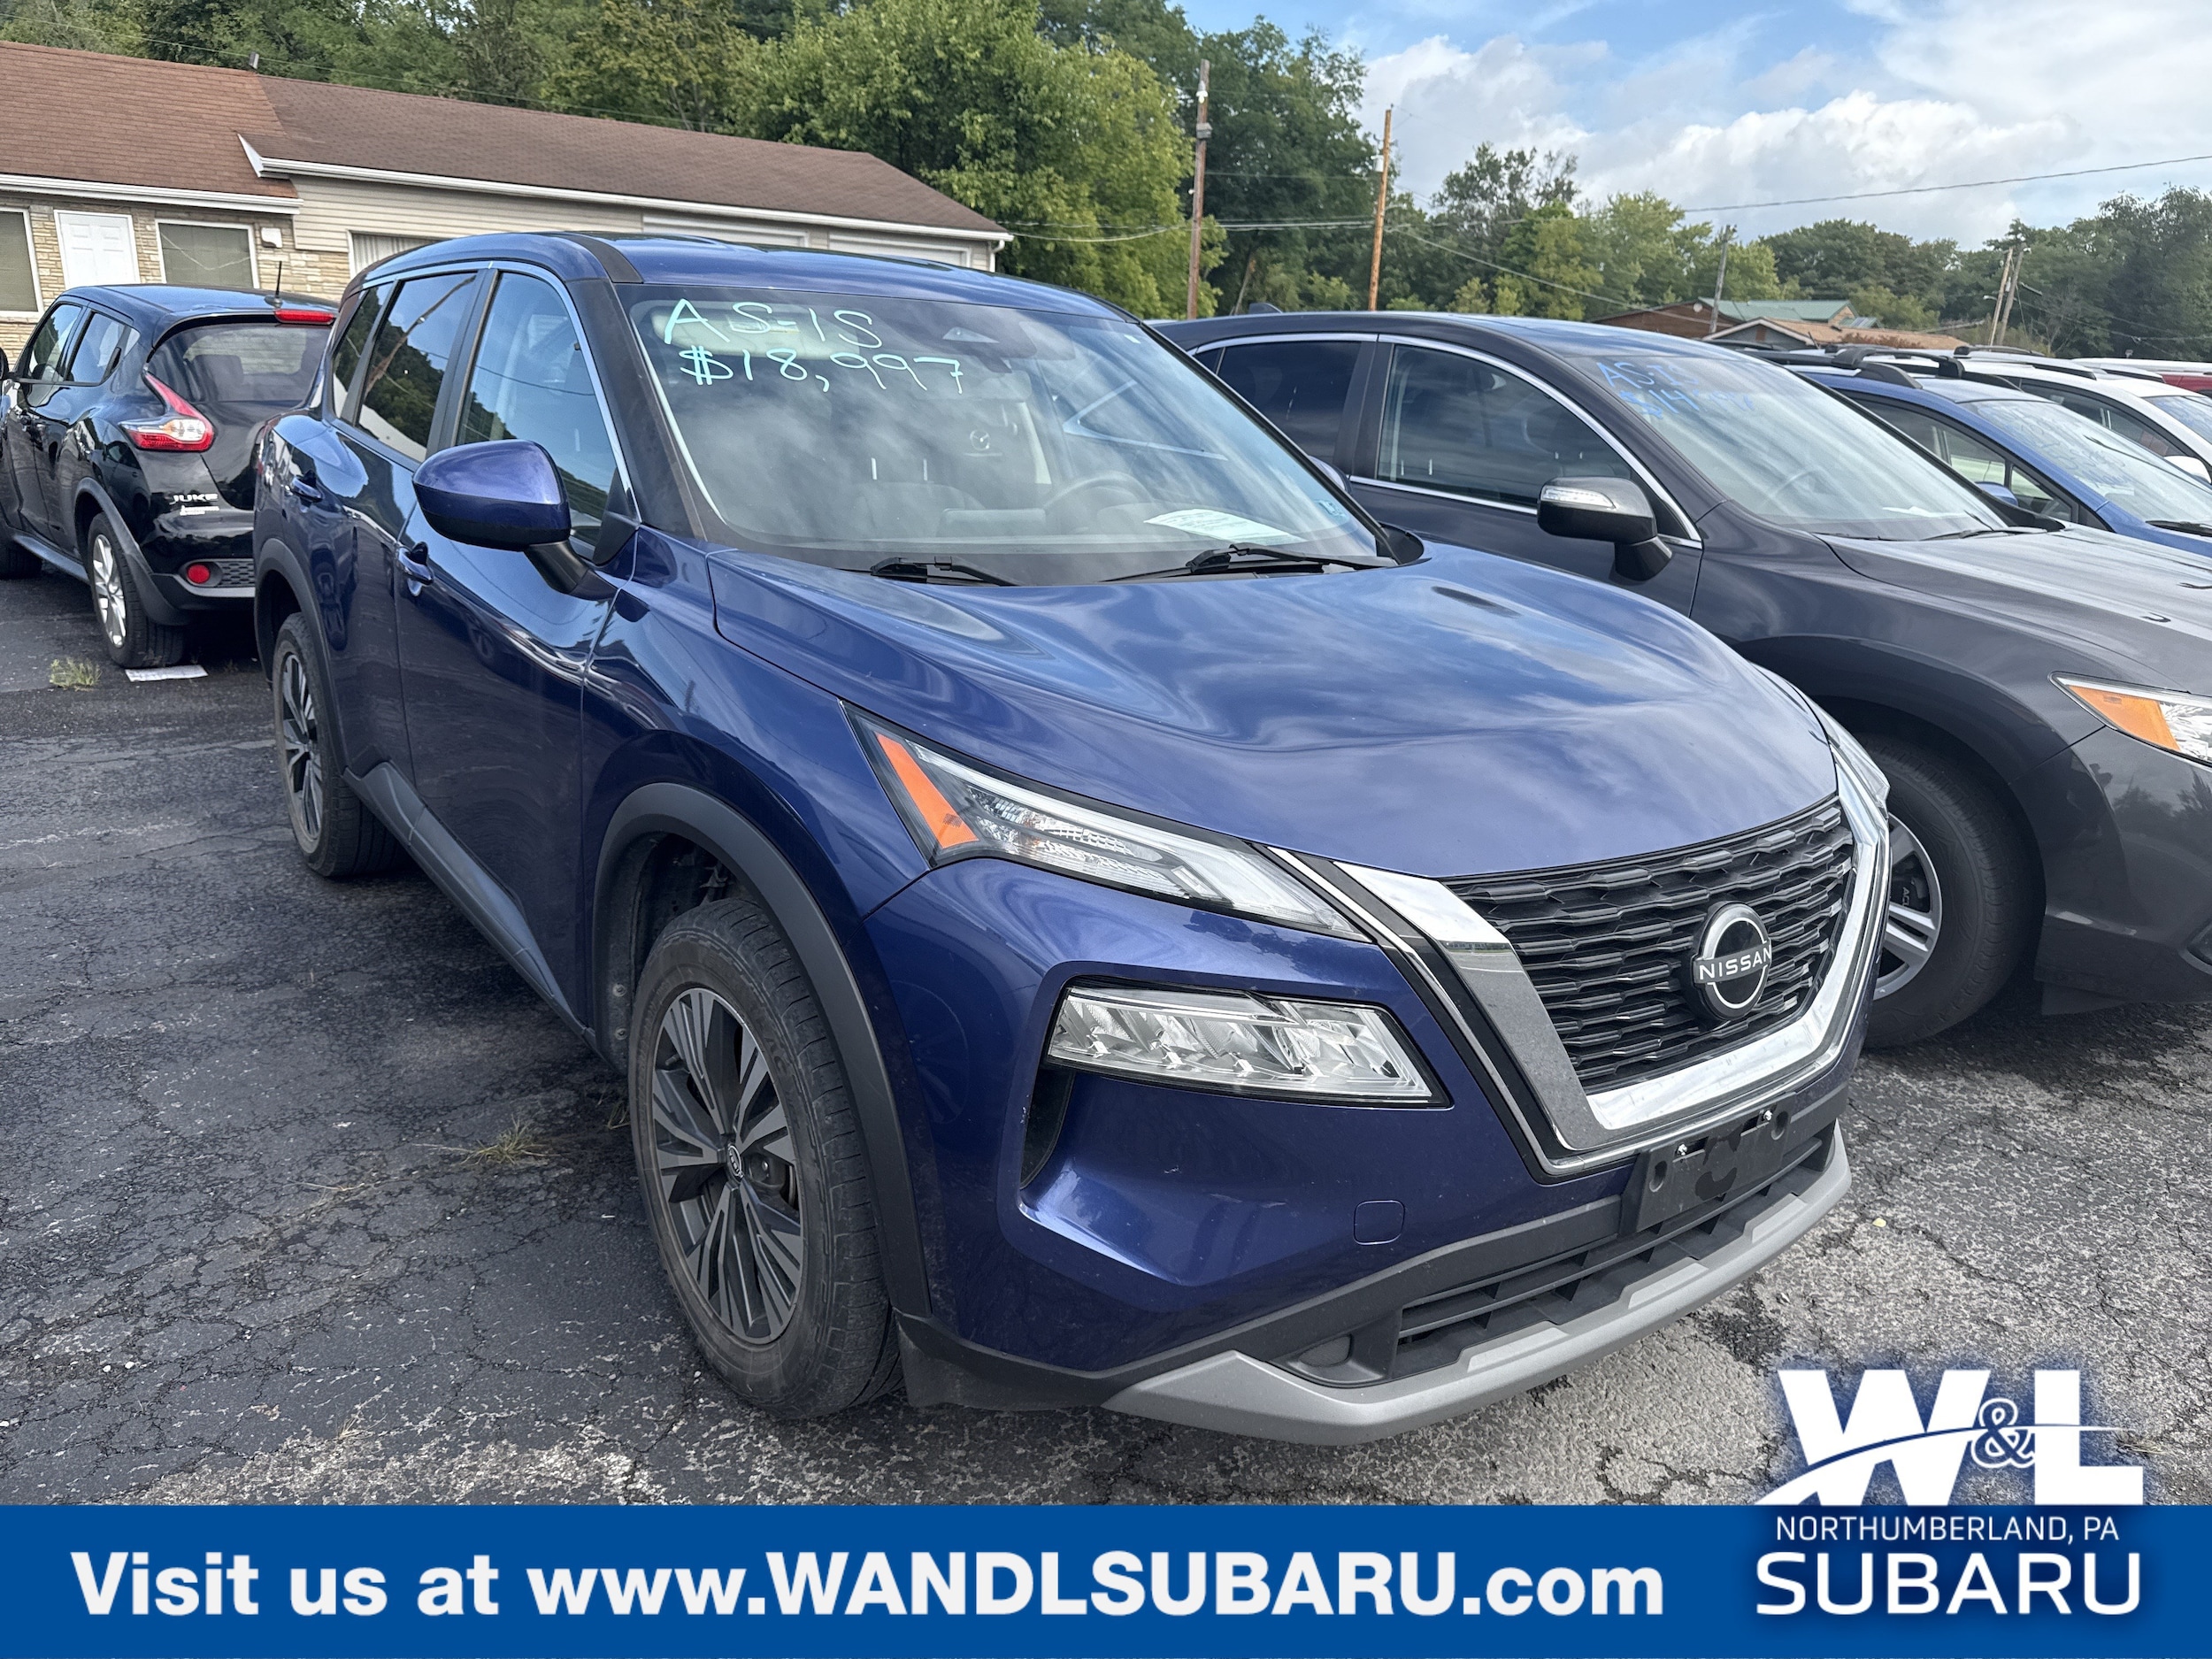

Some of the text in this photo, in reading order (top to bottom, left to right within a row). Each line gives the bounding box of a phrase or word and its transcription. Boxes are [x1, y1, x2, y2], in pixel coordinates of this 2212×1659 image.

[664, 297, 883, 349] AS-IS
[678, 344, 964, 395] $18,997
[169, 493, 218, 504] JUKE
[1698, 943, 1771, 981] NISSAN
